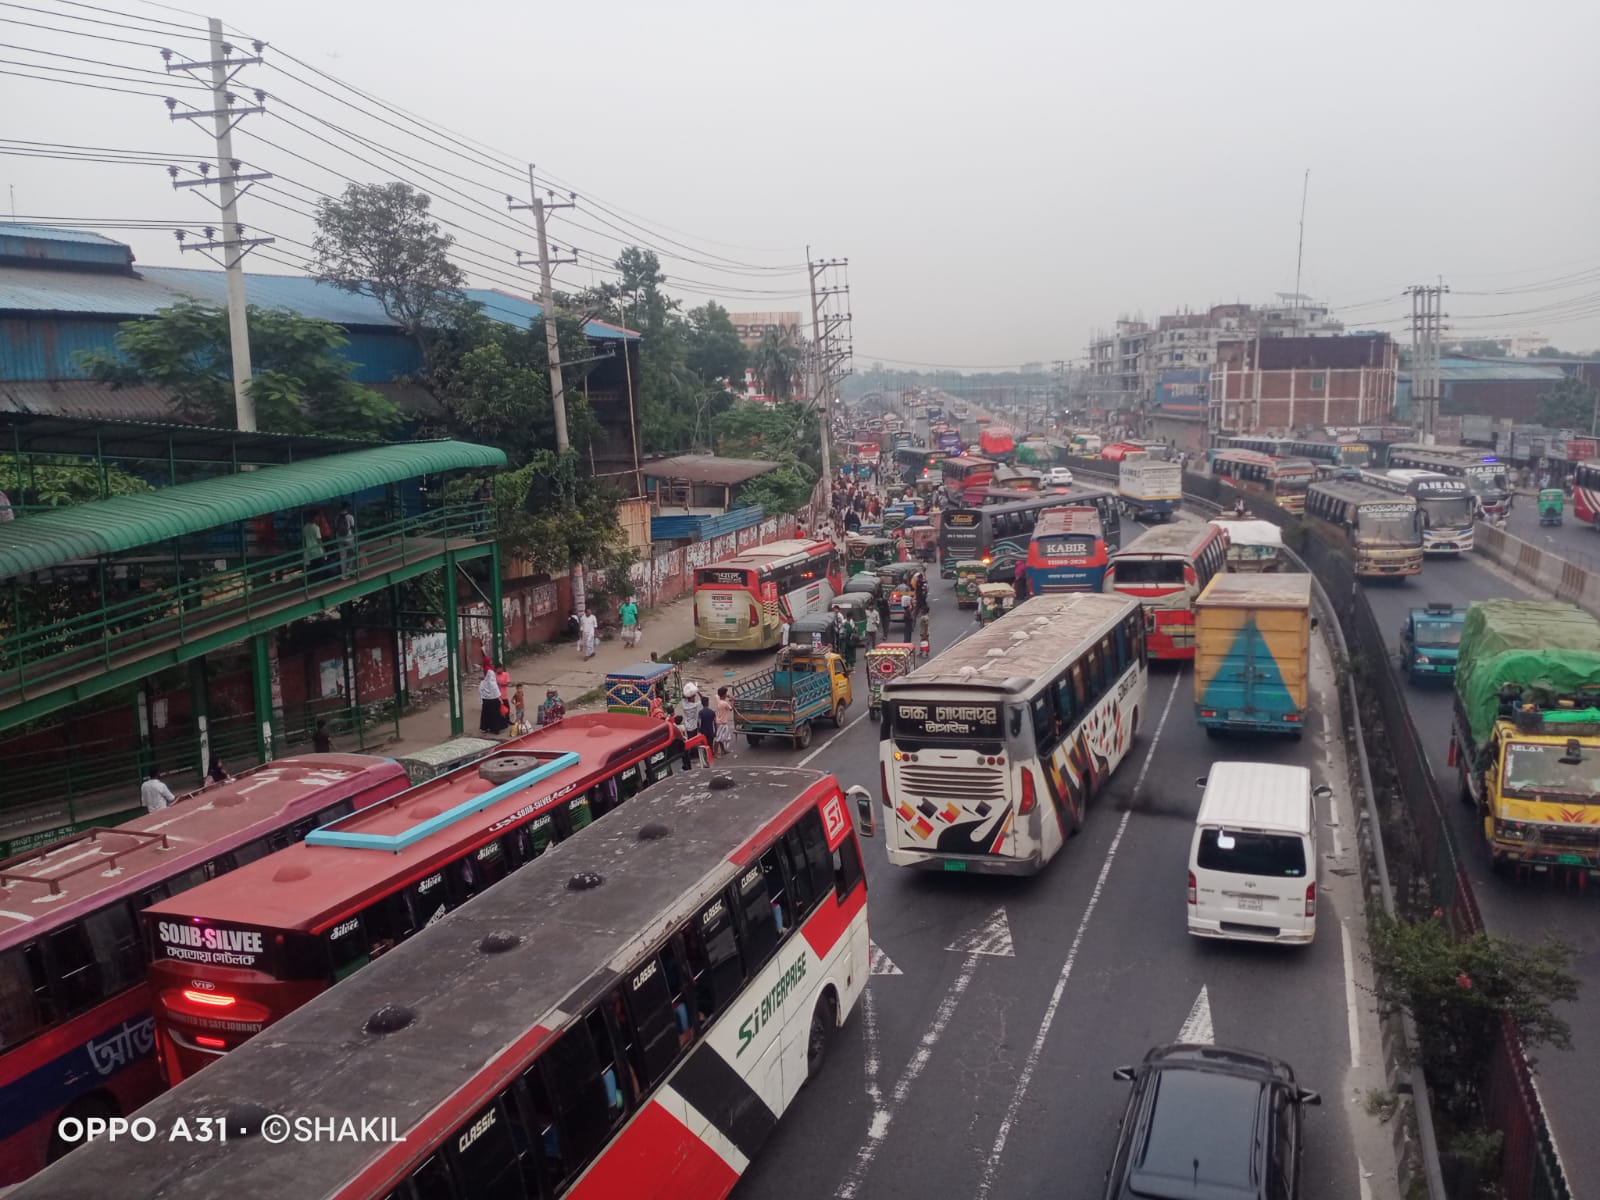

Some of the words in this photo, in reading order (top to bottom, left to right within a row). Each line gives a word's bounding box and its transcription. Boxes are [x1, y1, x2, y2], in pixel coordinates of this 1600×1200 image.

[1047, 543, 1087, 553] KABIR
[899, 705, 928, 720] ঢাকা
[936, 706, 997, 725] গোপালপুর
[760, 951, 806, 1027] ENTERPRISE
